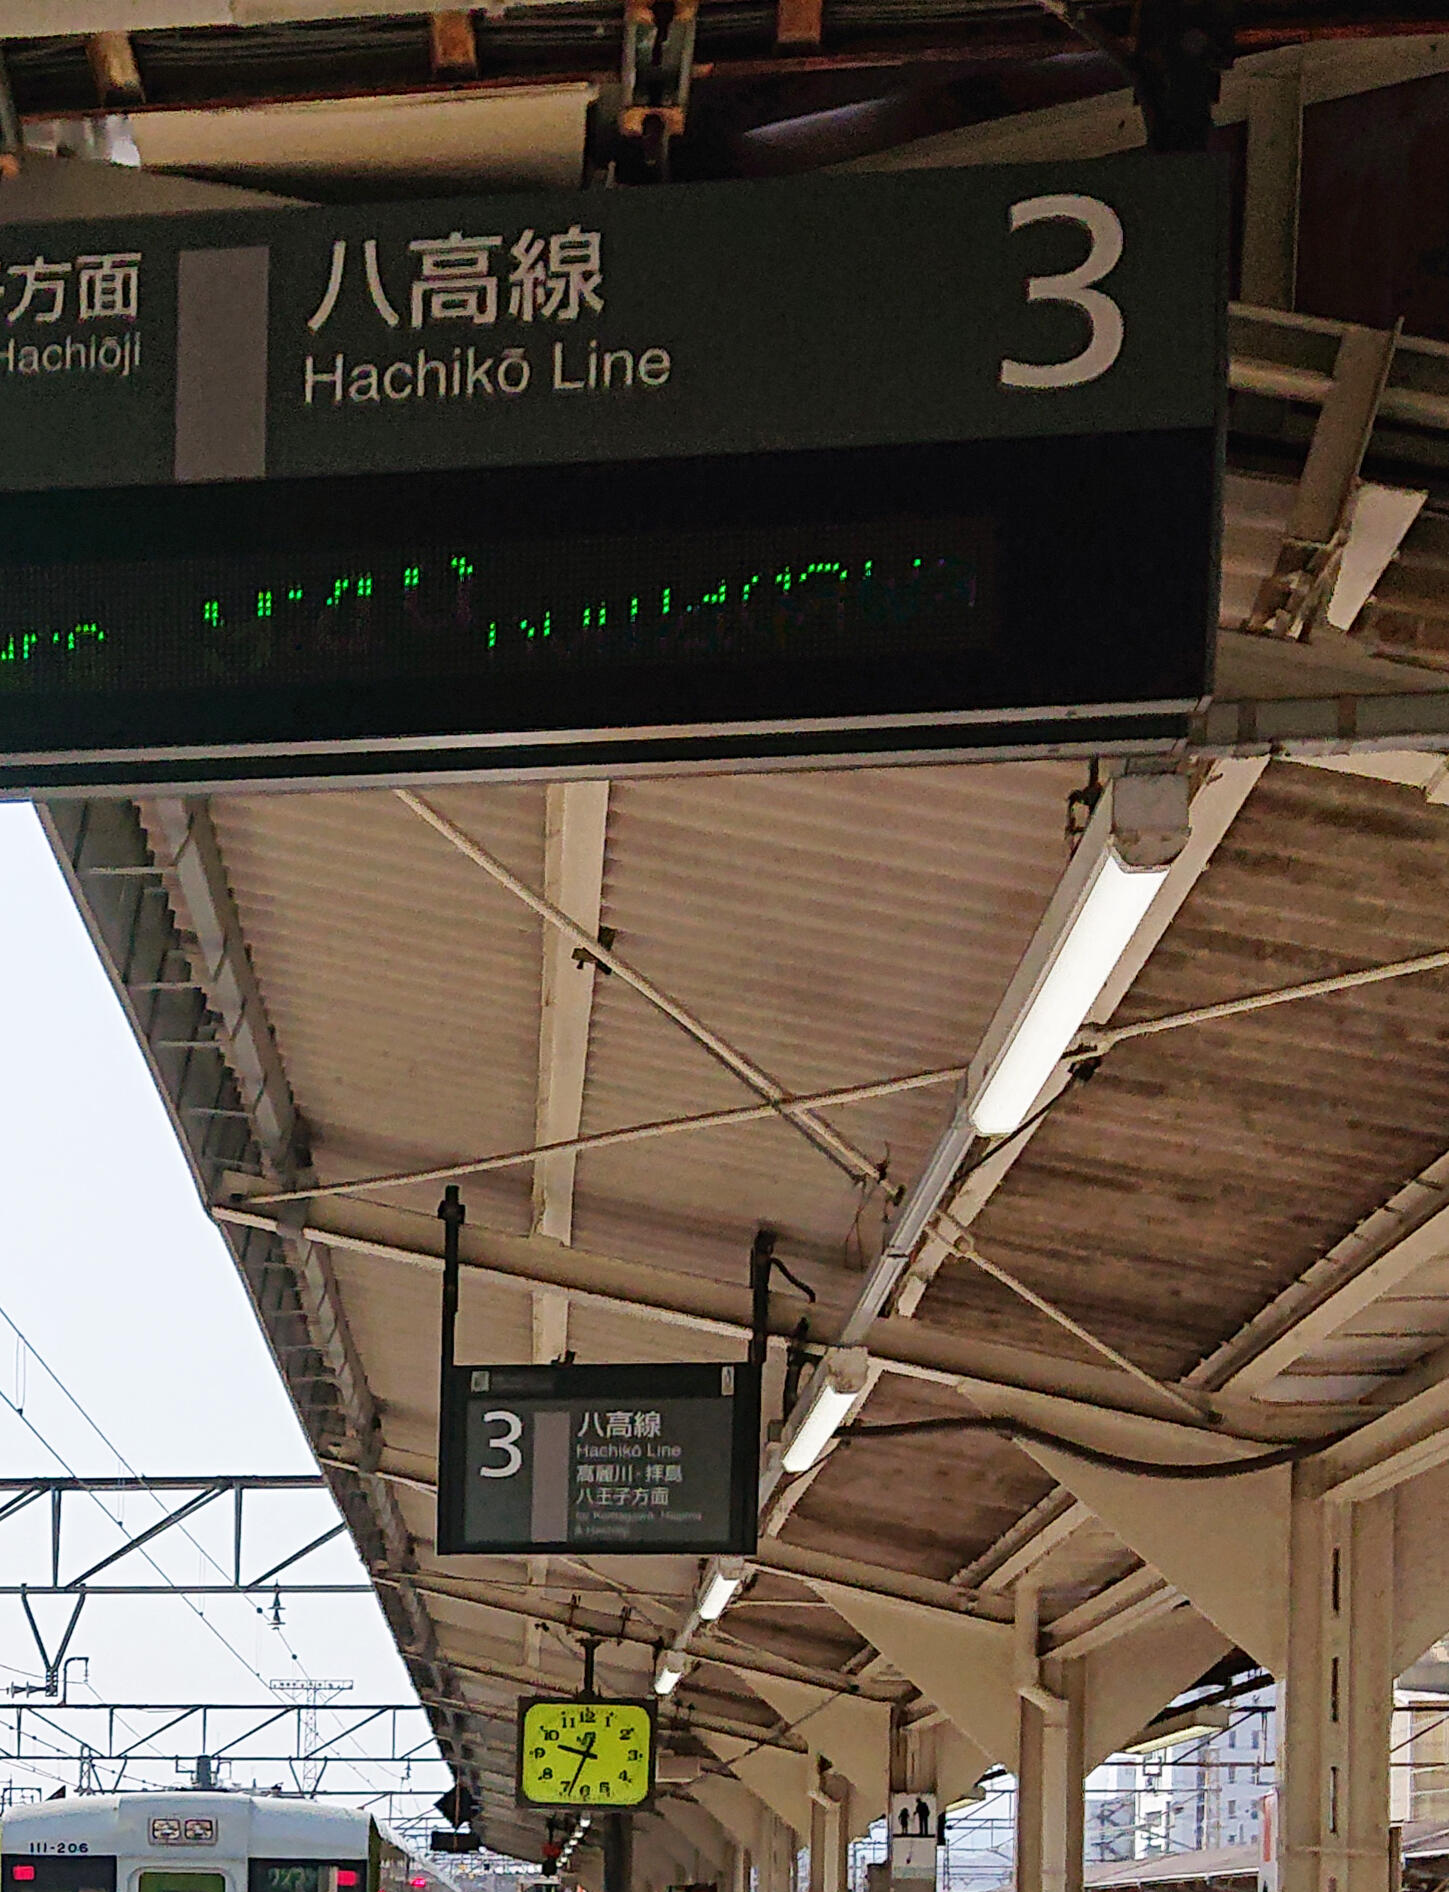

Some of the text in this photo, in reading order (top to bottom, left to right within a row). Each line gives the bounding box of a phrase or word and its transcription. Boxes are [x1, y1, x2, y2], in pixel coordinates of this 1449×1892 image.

[307, 224, 605, 333] 八高線
[998, 193, 1126, 389] 3
[305, 338, 672, 405] Hachikō Line
[577, 1411, 661, 1438] 八高線
[479, 1410, 523, 1479] 3
[647, 1443, 682, 1458] Line
[576, 1487, 669, 1506] 八王子方面
[562, 1716, 575, 1728] 11
[579, 1711, 596, 1723] 12
[605, 1716, 611, 1727] 1
[544, 1729, 560, 1741] 10
[619, 1729, 631, 1740] 2
[534, 1747, 546, 1759] 9
[627, 1749, 638, 1761] 3
[542, 1767, 553, 1780] 8
[618, 1770, 628, 1781] 4
[560, 1781, 571, 1793] 7
[599, 1782, 610, 1794] 5
[30, 1842, 89, 1853] 111-206
